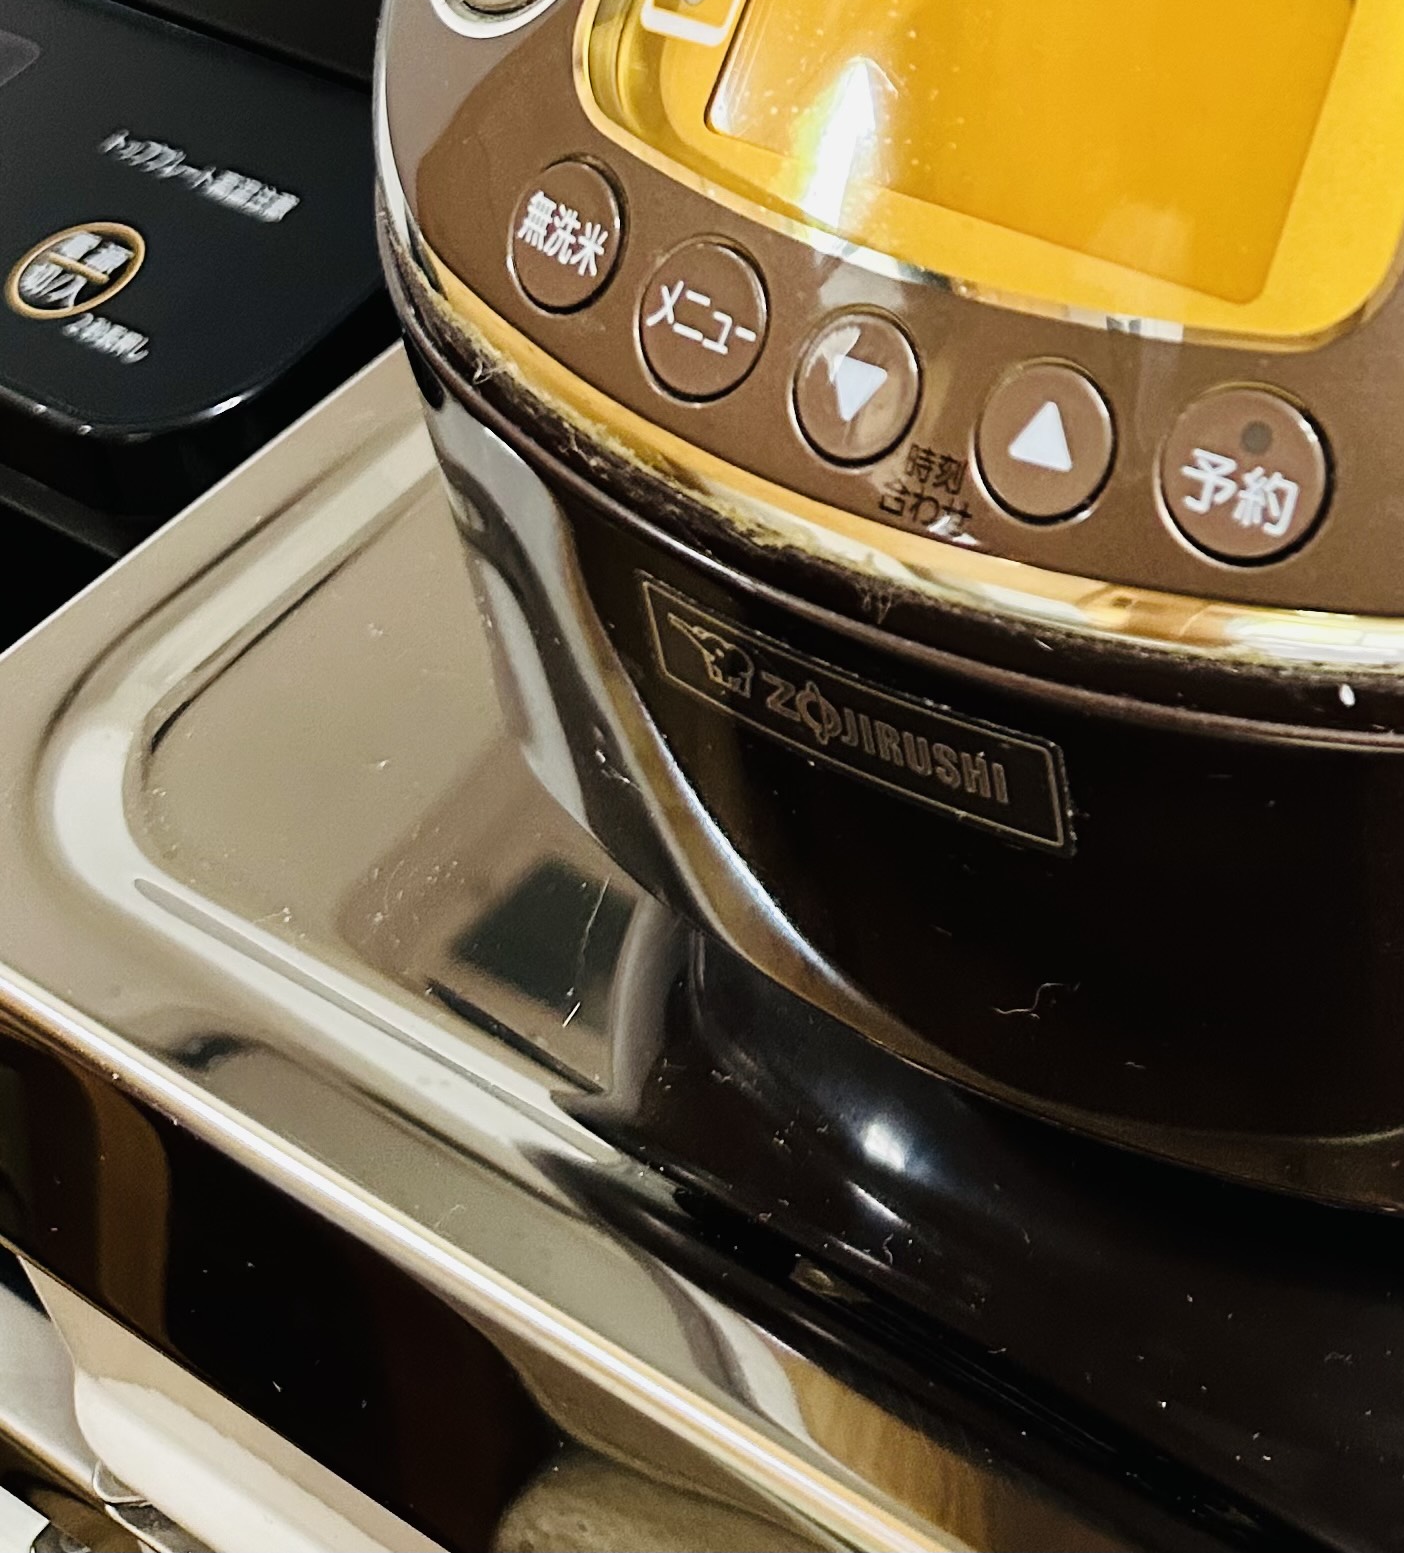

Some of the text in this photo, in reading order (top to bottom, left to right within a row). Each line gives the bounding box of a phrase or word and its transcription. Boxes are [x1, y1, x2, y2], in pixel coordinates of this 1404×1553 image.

[517, 190, 608, 277] 無洗米
[646, 280, 757, 355] メニュー
[905, 443, 968, 495] 時刻
[1180, 447, 1299, 537] 予約
[758, 670, 1009, 805] ZOJIRUSHI
